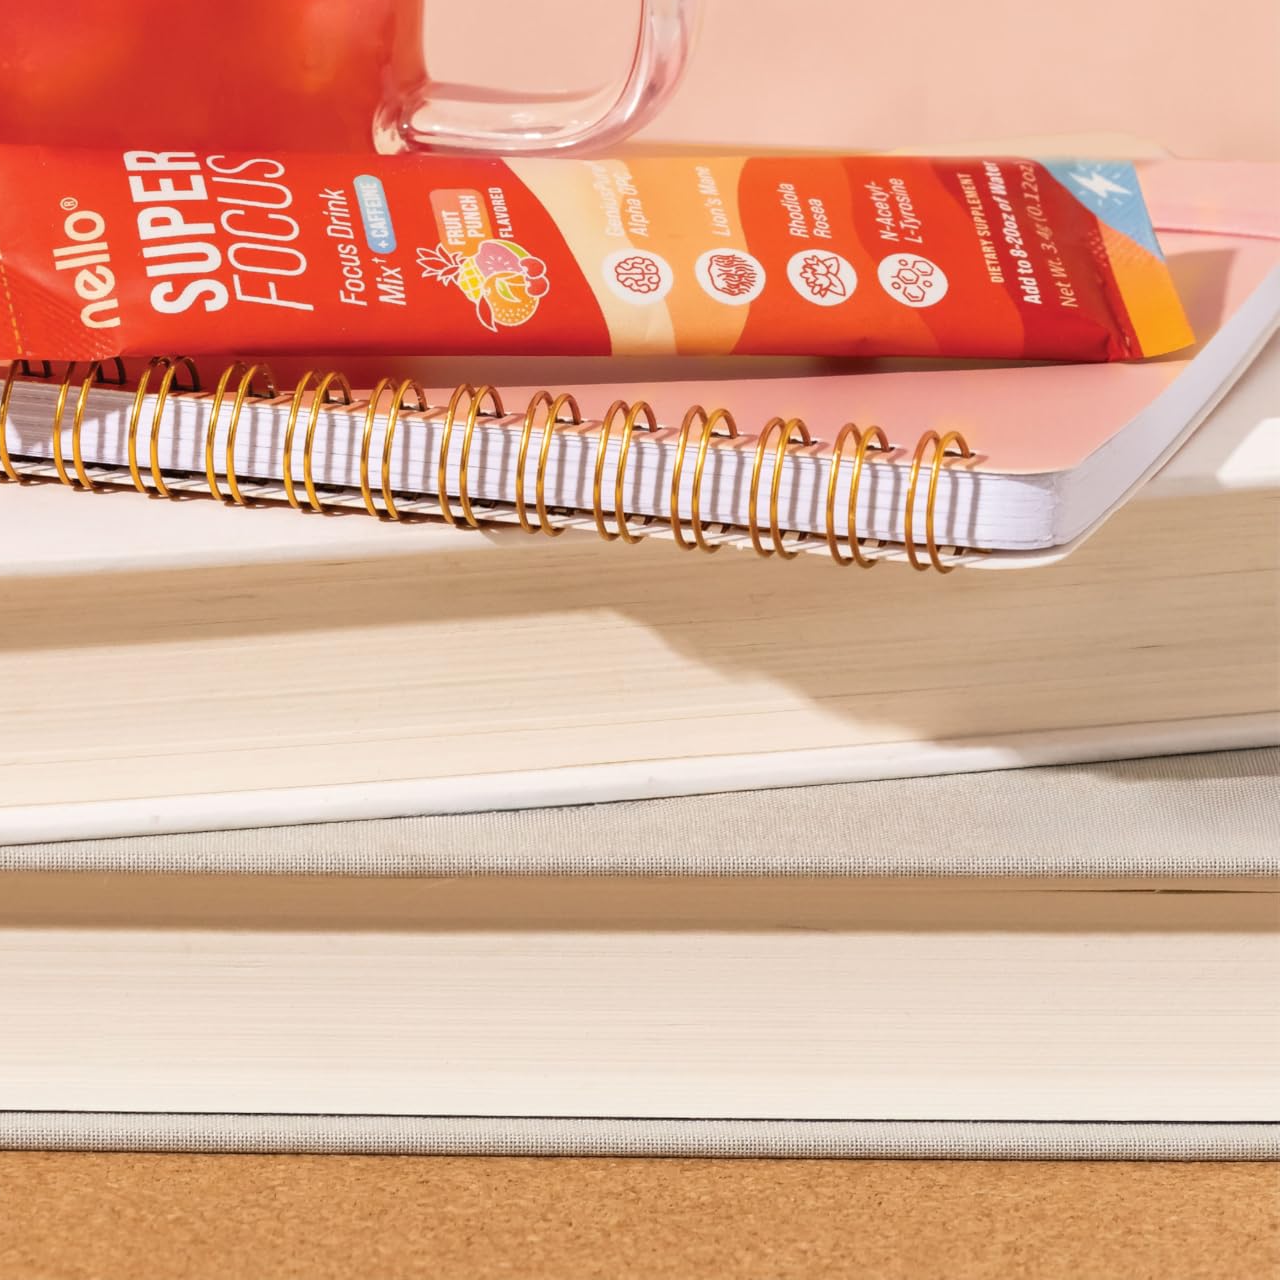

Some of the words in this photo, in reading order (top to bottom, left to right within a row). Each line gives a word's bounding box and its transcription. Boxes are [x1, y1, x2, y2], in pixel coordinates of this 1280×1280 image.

[694, 165, 721, 196] Mane
[982, 160, 1008, 197] Water
[319, 188, 355, 240] Drink
[359, 182, 389, 239] CAFFEINE
[458, 195, 485, 238] PUNCH
[488, 186, 514, 239] FLAVORED
[624, 197, 651, 238] Alpha
[704, 196, 731, 238] Lion's
[777, 182, 810, 239] Rhodiola
[808, 198, 832, 239] Rosea
[864, 181, 899, 242] N-Acetyl-
[889, 177, 923, 244] L-Tyrosine
[956, 172, 991, 238] SUPPLEMENT
[992, 196, 1013, 212] of
[123, 150, 230, 314] SUPER
[206, 154, 314, 311] FOCUS
[441, 209, 466, 246] FRUIT
[1002, 212, 1028, 259] 8-20oz
[337, 243, 368, 306] Focus
[978, 238, 1004, 284] DIETARY
[1016, 260, 1034, 275] to
[1047, 256, 1067, 278] Wt.
[1018, 276, 1042, 305] Add
[1055, 282, 1079, 308] Net
